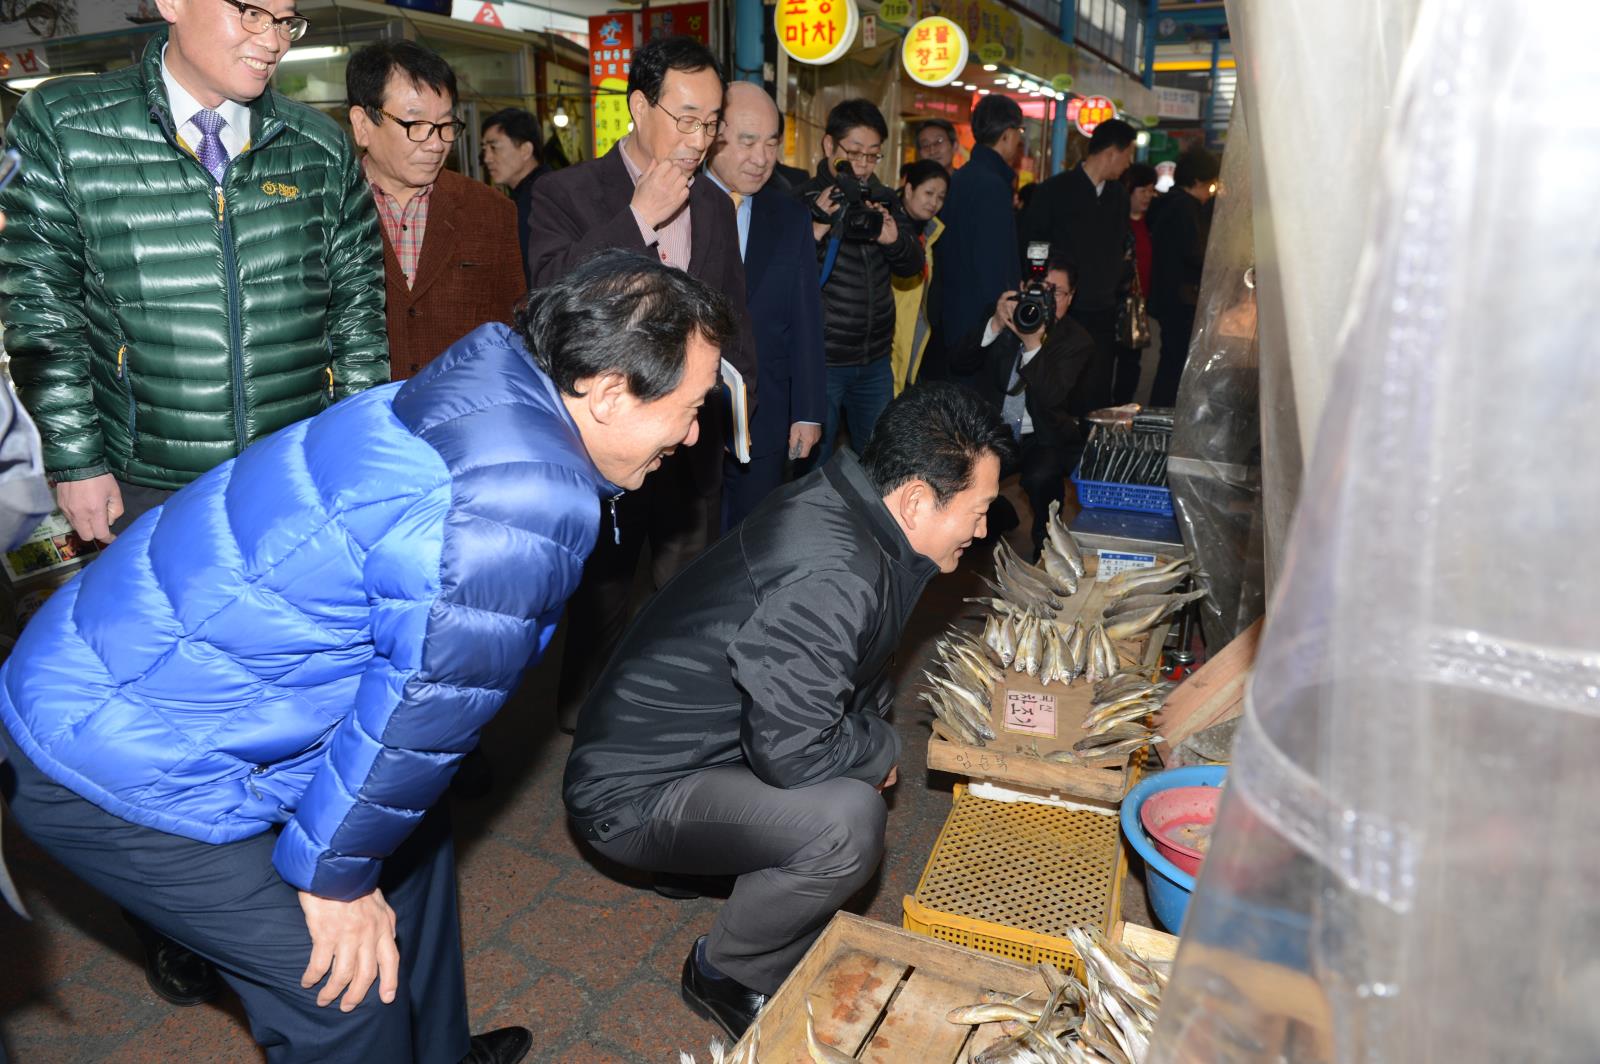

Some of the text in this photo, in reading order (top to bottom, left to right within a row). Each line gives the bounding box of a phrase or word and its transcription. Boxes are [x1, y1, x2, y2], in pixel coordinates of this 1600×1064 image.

[483, 9, 495, 23] 2
[785, 20, 836, 47] 마차
[915, 26, 950, 44] 보물
[915, 47, 949, 66] 창고
[1008, 693, 1039, 729] 참조기
